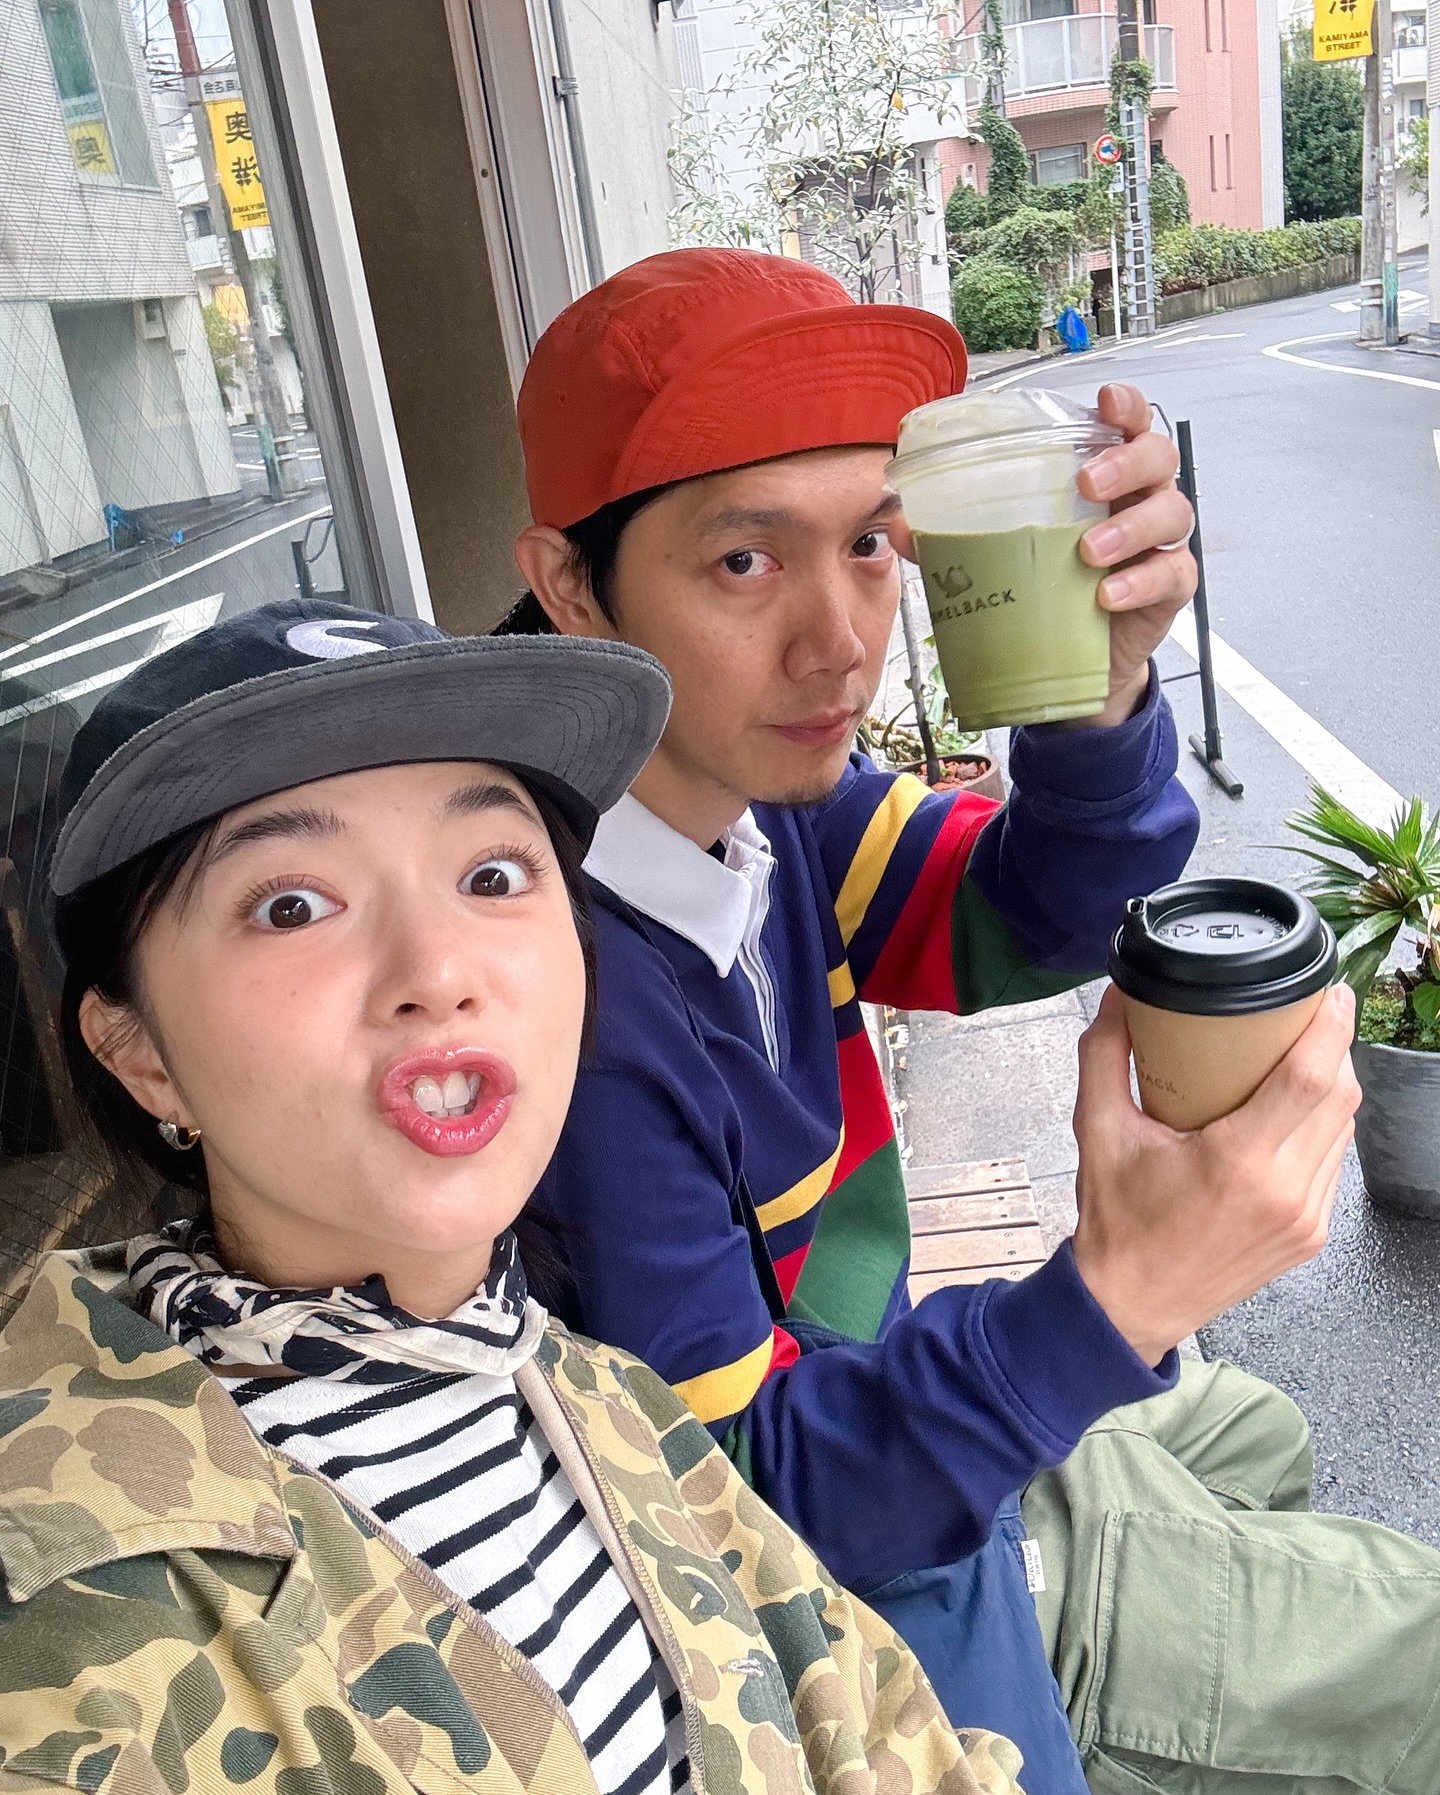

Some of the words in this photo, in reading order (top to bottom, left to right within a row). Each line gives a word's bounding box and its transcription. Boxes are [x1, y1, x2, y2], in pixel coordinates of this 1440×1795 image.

[1319, 30, 1369, 43] KAMIYAMA
[1326, 41, 1361, 52] STREET
[932, 588, 1016, 625] MELBACK
